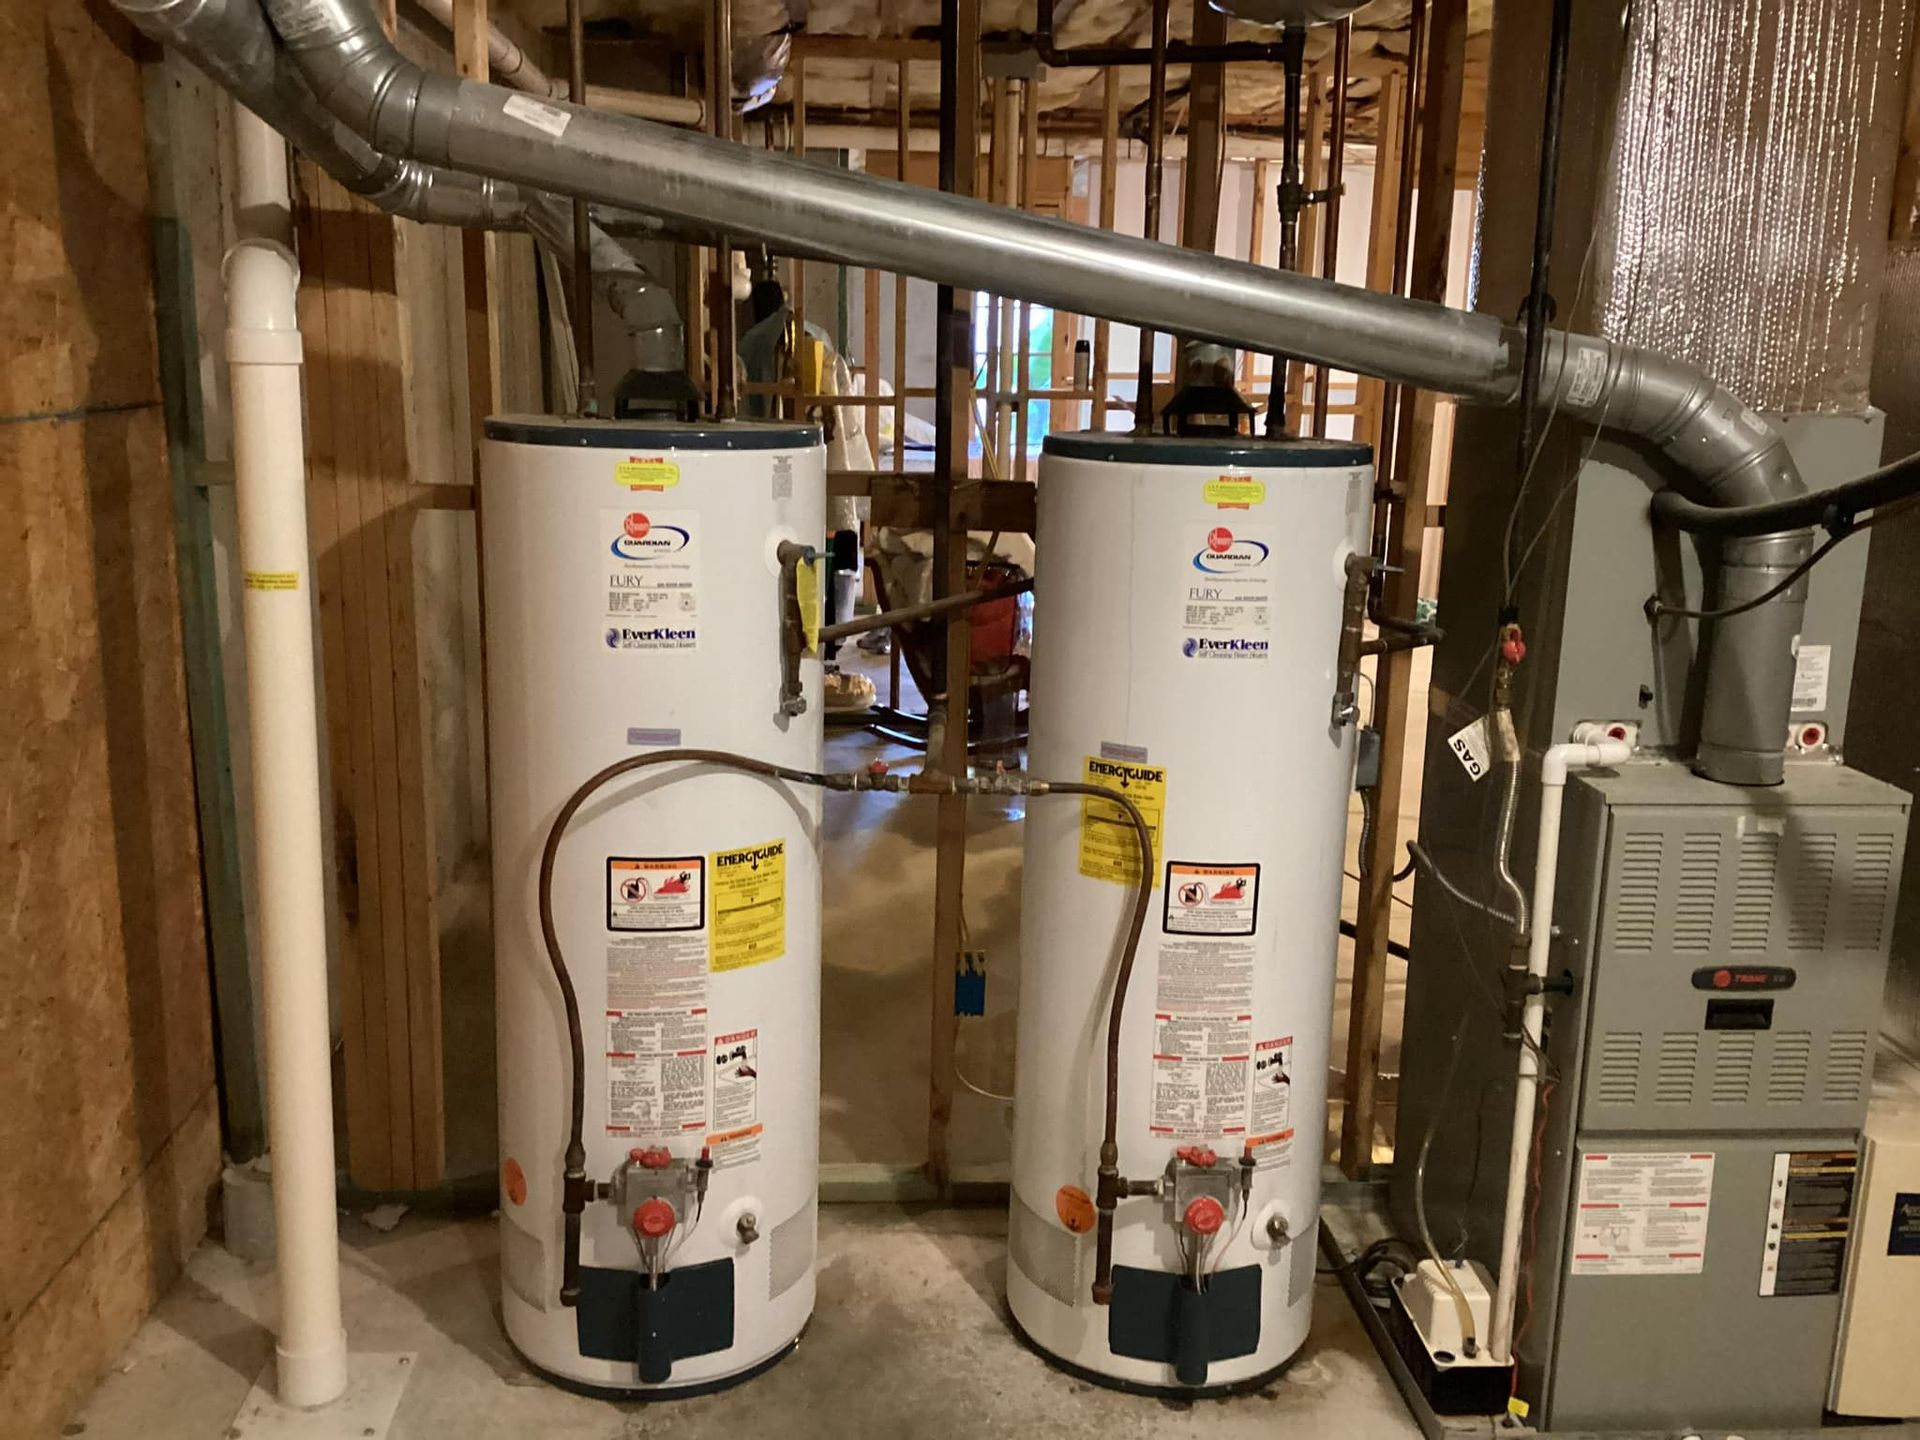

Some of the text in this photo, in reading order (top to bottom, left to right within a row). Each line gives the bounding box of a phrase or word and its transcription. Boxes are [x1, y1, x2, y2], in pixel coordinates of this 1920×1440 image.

[624, 539, 671, 547] GUARDIAN
[1206, 553, 1252, 561] GUARDIAN
[609, 574, 643, 588] FURY
[1189, 587, 1222, 600] FURY
[622, 628, 696, 641] EverKleen
[1199, 638, 1269, 651] EverKleen
[1454, 738, 1481, 775] GAS
[1089, 761, 1163, 784] ENERGYGUIDE
[717, 843, 783, 869] ENERGYGUIDE
